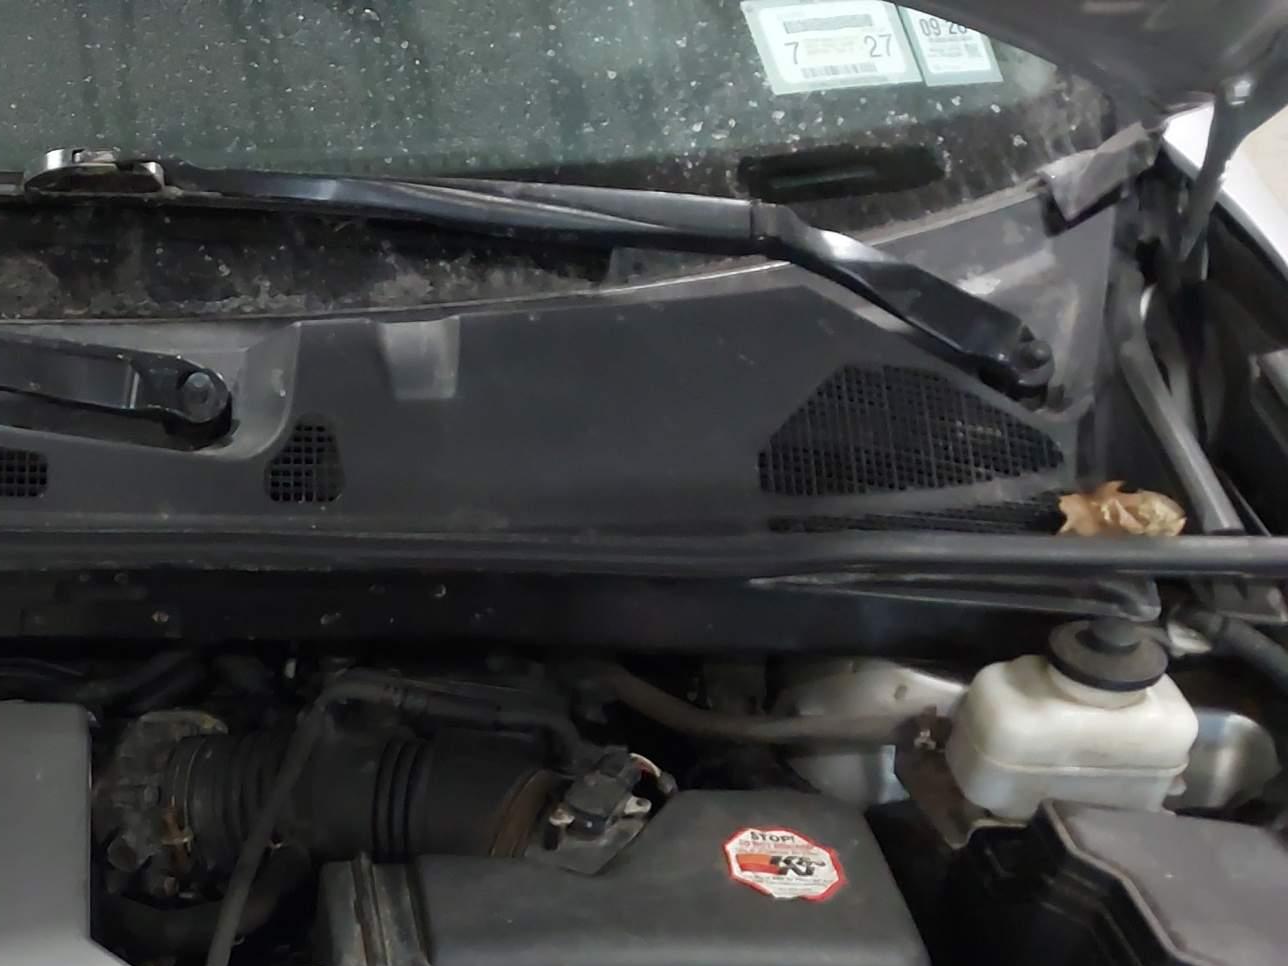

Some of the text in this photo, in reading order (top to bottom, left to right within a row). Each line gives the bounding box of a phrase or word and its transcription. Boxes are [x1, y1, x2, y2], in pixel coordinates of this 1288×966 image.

[919, 17, 942, 36] 09
[784, 41, 800, 65] 7
[864, 34, 892, 58] 27
[750, 831, 795, 842] STOP!
